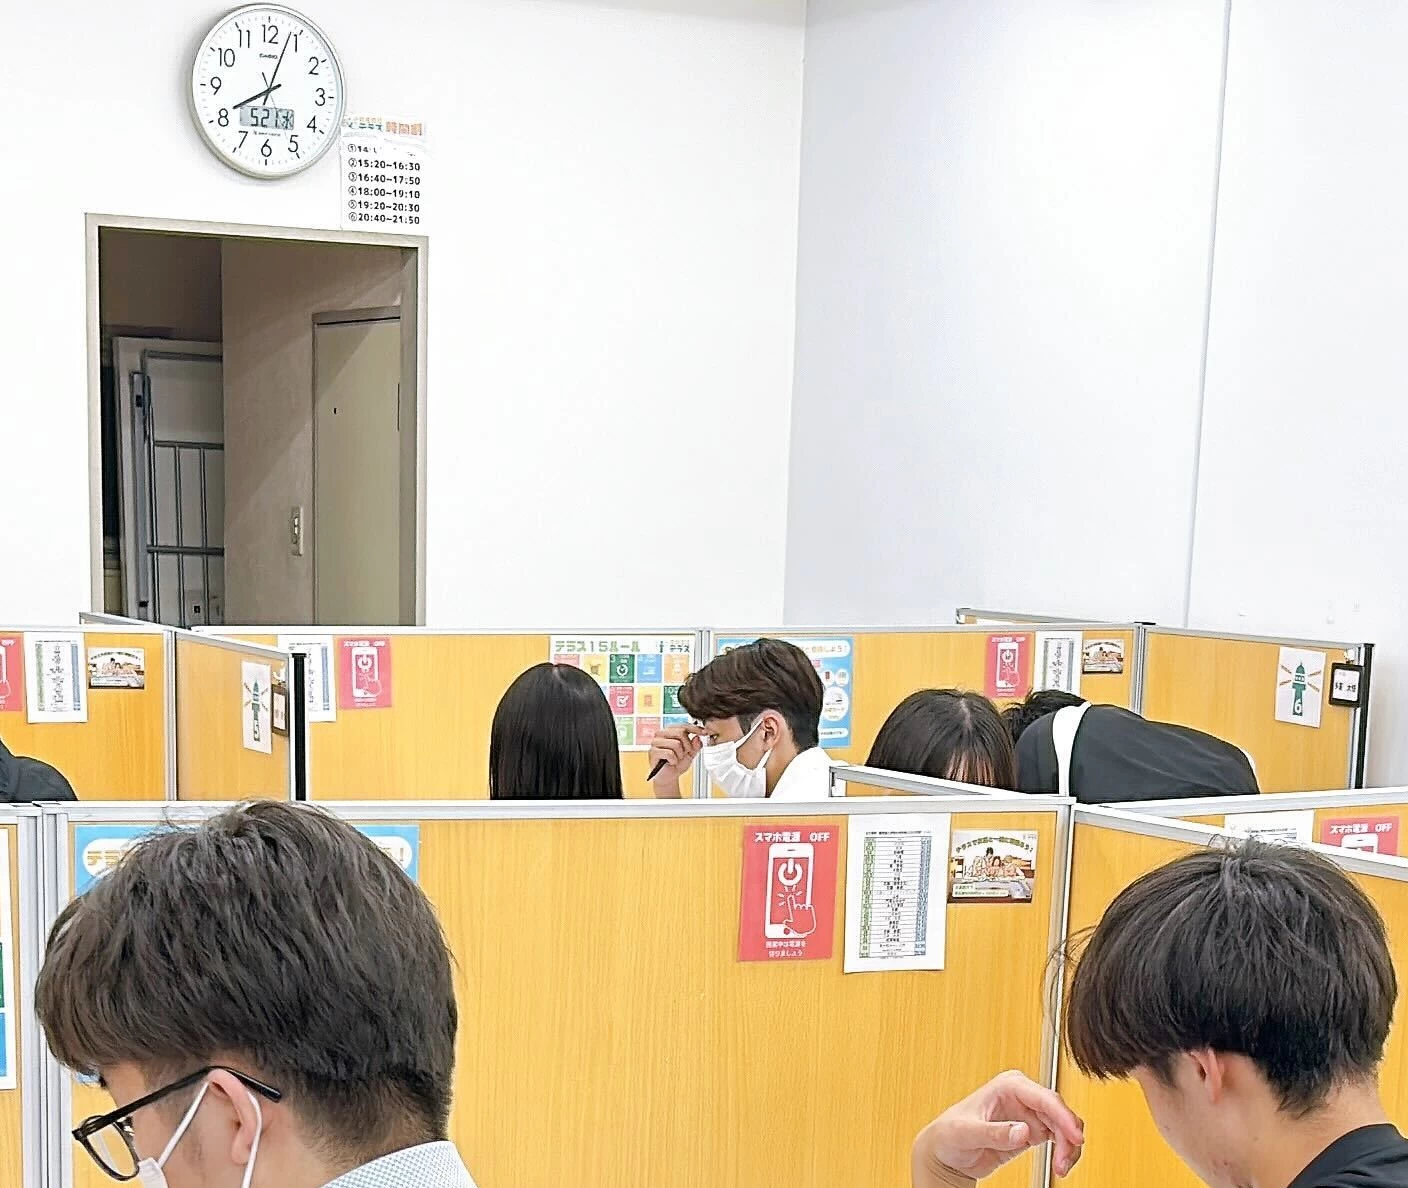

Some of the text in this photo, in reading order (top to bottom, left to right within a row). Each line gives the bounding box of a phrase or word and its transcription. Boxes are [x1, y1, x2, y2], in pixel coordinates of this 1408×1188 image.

[238, 28, 250, 48] 11
[261, 24, 278, 44] 12
[294, 34, 298, 52] 1
[218, 48, 236, 68] 10
[308, 56, 319, 75] 2
[210, 76, 222, 96] 9
[314, 88, 326, 106] 3
[218, 108, 230, 128] 8
[306, 115, 318, 133] 4
[238, 130, 248, 148] 7
[260, 139, 272, 158] 6
[288, 134, 298, 153] 5
[1294, 700, 1303, 714] 6
[809, 831, 830, 842] OFF
[1374, 823, 1392, 833] OFF
